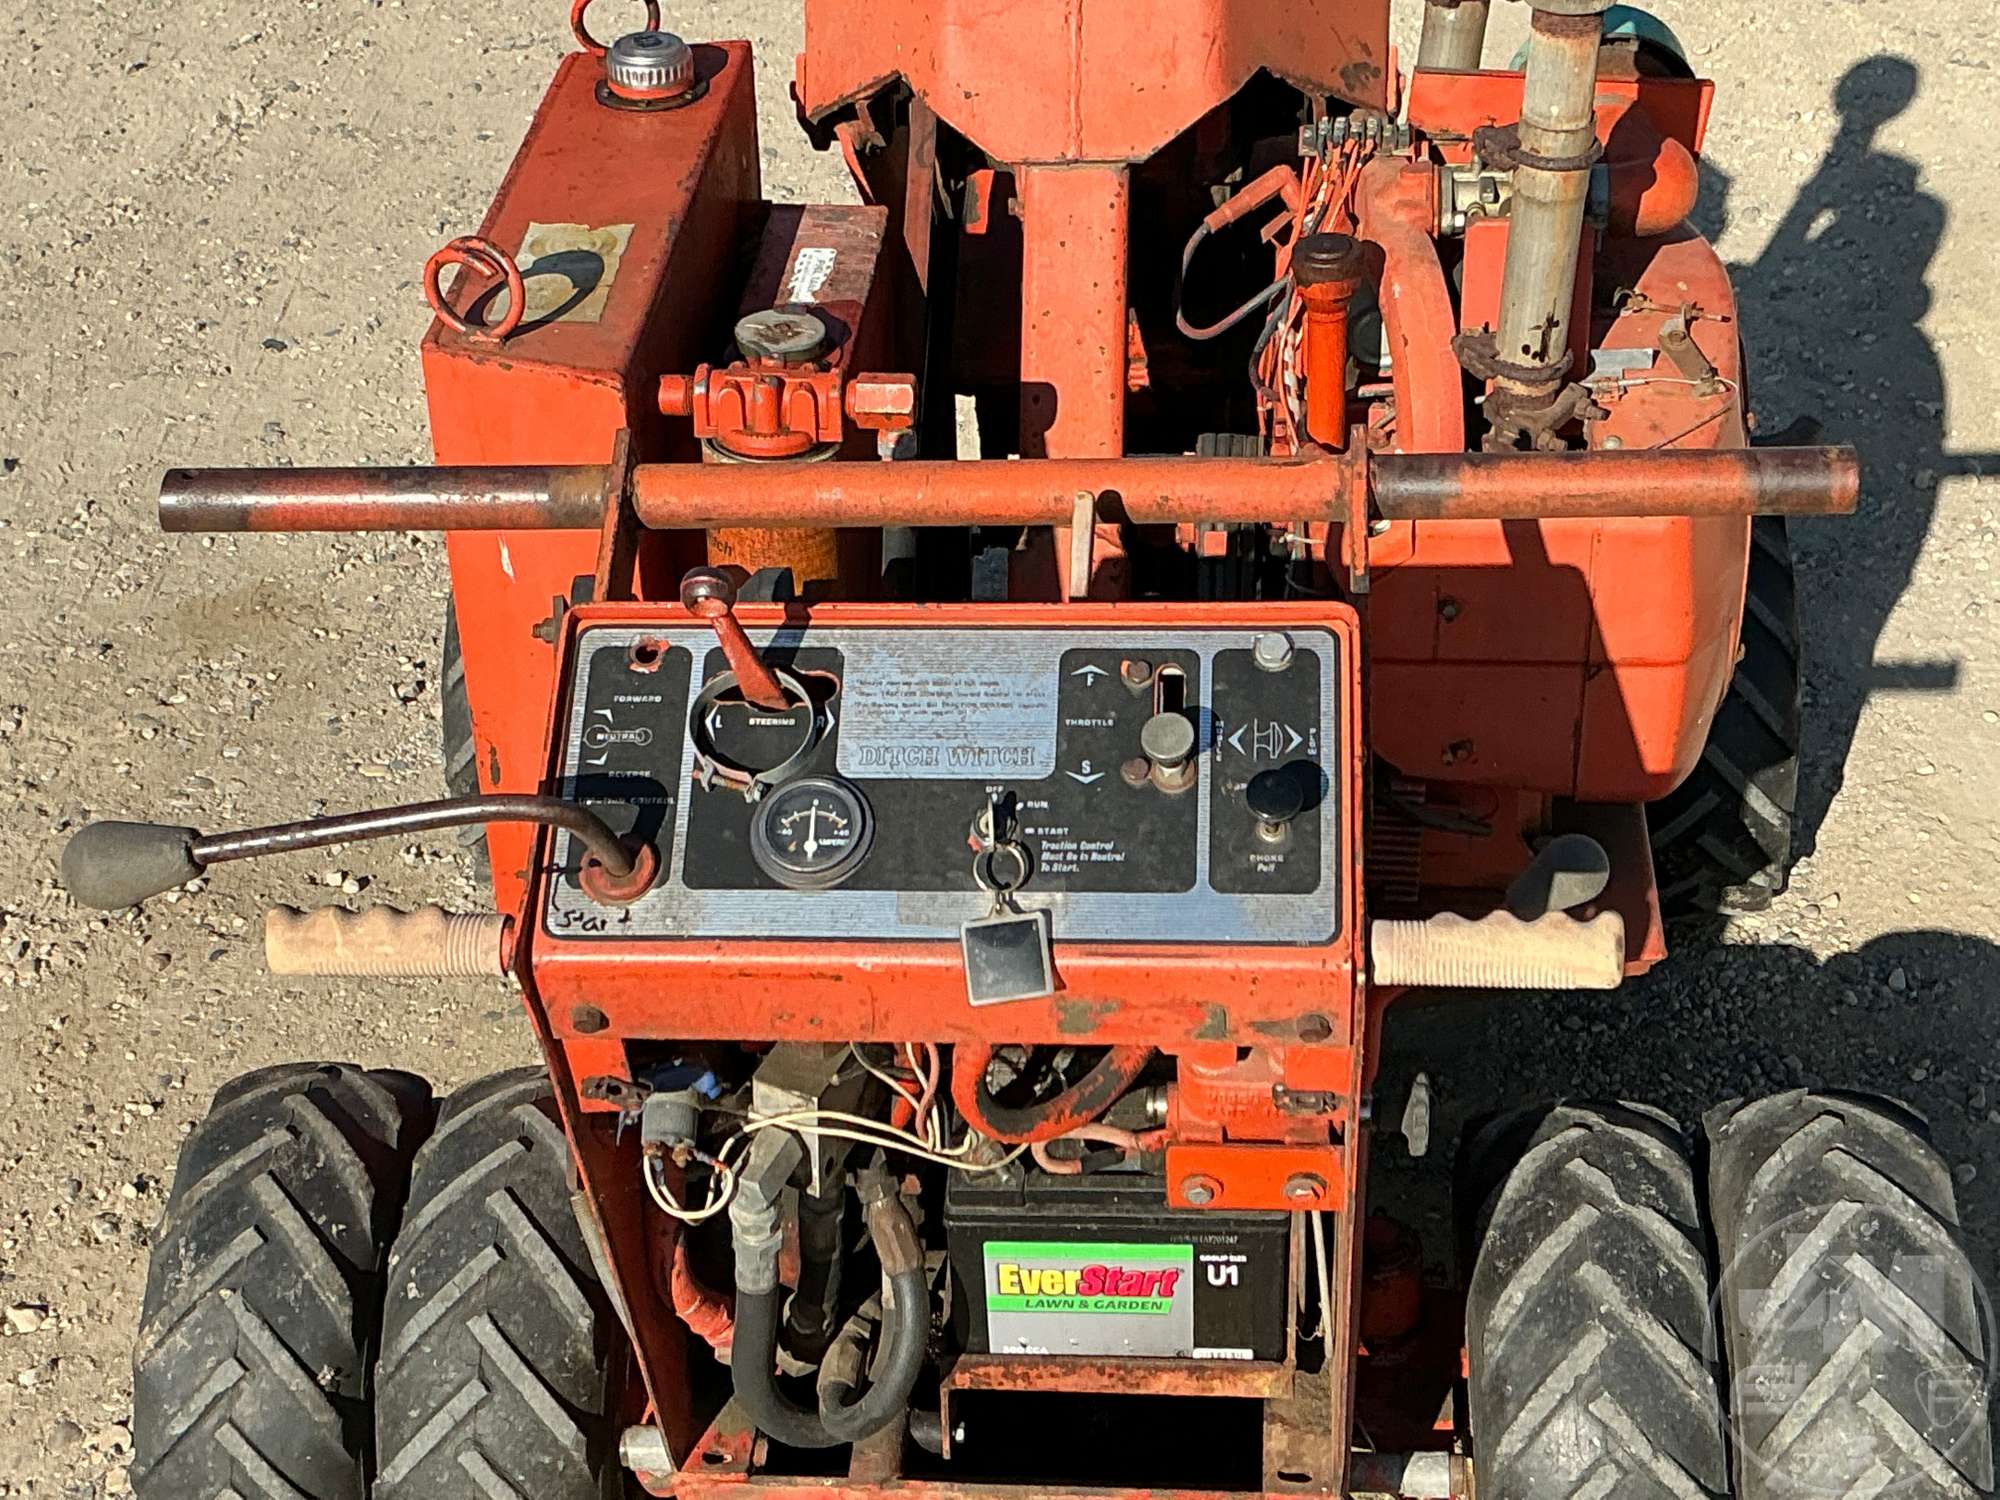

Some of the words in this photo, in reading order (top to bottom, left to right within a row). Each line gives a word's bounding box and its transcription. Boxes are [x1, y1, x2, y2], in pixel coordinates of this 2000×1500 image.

[1086, 673, 1095, 687] F
[613, 694, 663, 703] FORWARD
[715, 714, 723, 729] L
[748, 717, 796, 726] STEERING
[1064, 718, 1115, 727] THROTTLE
[596, 732, 642, 741] NEUTRAL
[858, 744, 940, 767] DITCH
[947, 744, 1036, 767] WITCH
[1081, 759, 1092, 775] S
[608, 770, 652, 778] REVERSE
[985, 785, 1004, 794] OFF
[1026, 800, 1049, 809] RUN
[1037, 827, 1069, 835] START
[1041, 840, 1078, 851] Traction
[1080, 840, 1115, 851] Control
[1041, 852, 1064, 862] Must
[1091, 852, 1126, 863] Neutral
[1249, 854, 1285, 862] CHOKE
[1041, 862, 1051, 872] To
[1052, 862, 1080, 873] Start.
[1256, 863, 1275, 873] Pull
[998, 1262, 1180, 1298] EverStart
[1207, 1264, 1239, 1287] U1
[1024, 1298, 1075, 1310] LAWN
[1078, 1300, 1091, 1310] &
[1093, 1300, 1163, 1311] GARDEN
